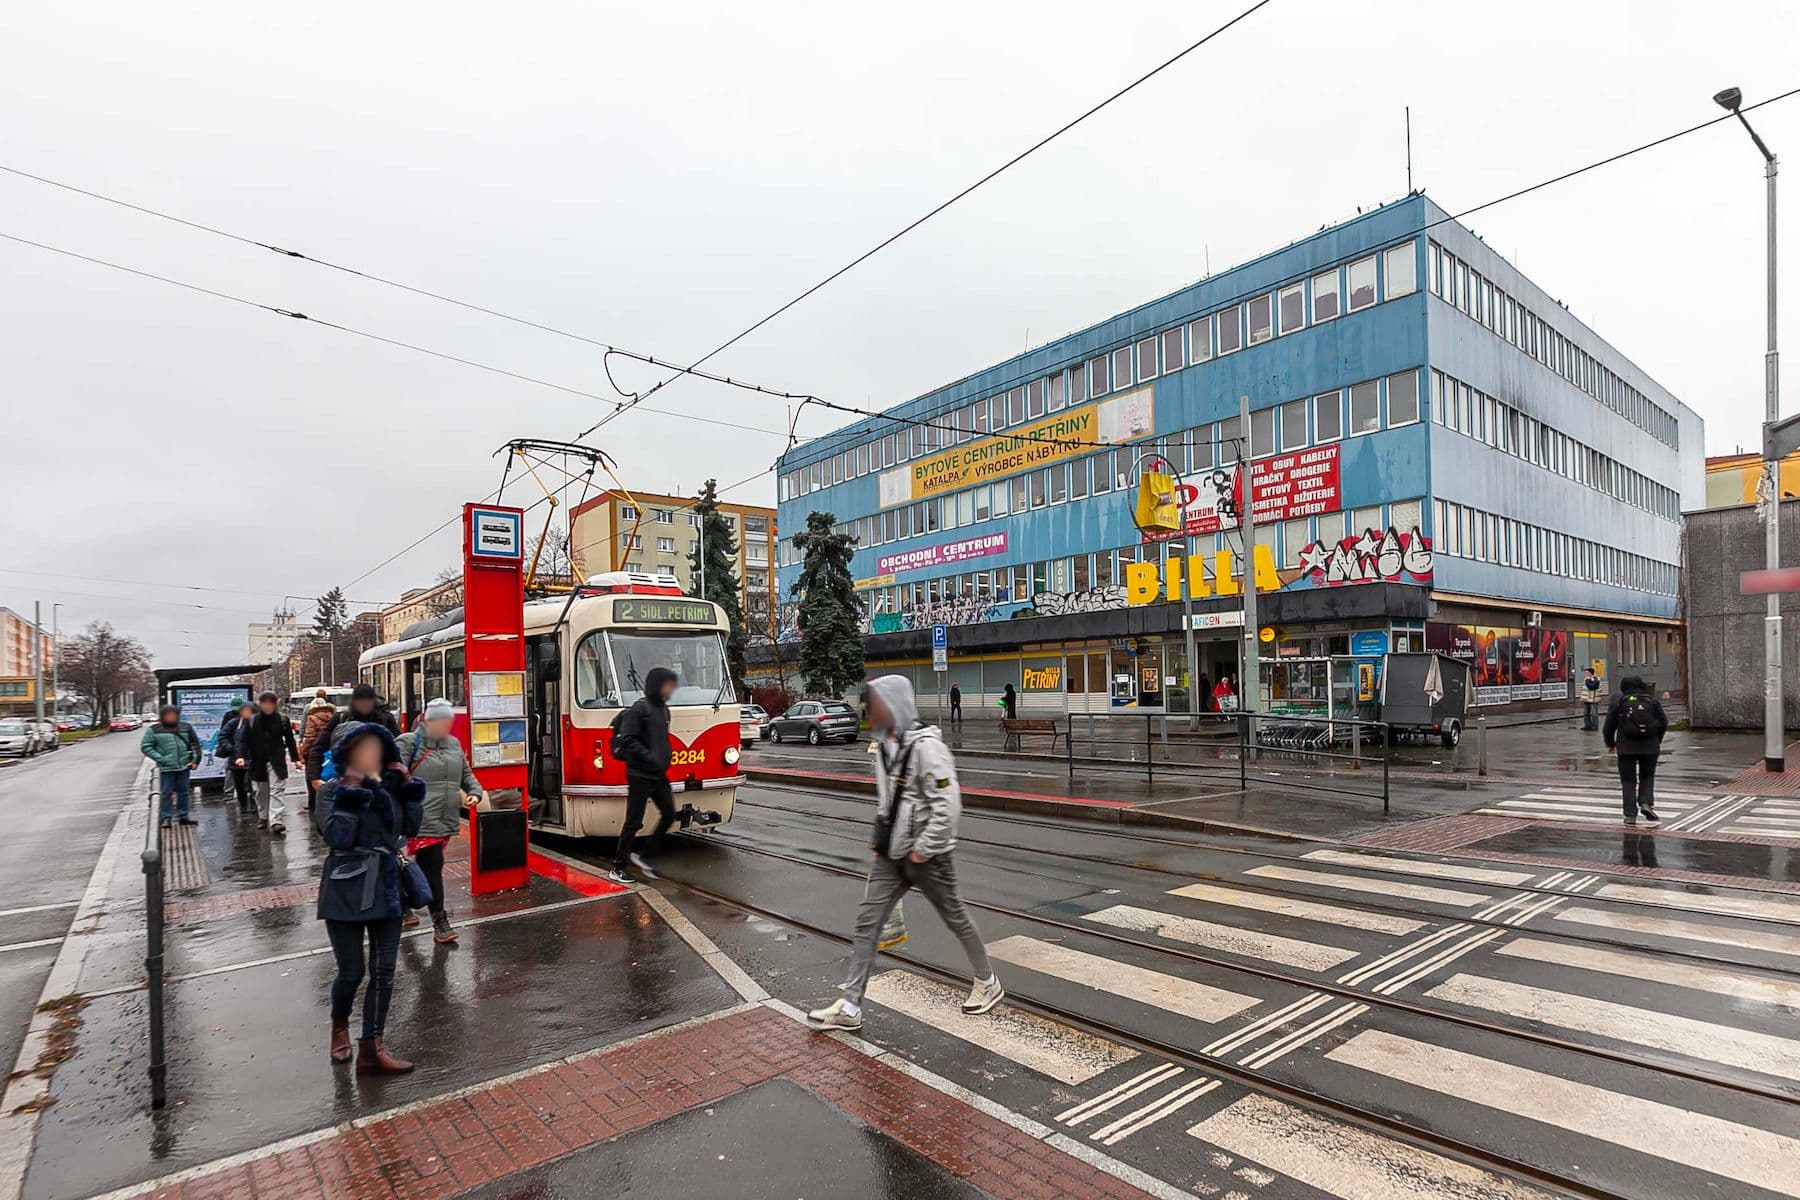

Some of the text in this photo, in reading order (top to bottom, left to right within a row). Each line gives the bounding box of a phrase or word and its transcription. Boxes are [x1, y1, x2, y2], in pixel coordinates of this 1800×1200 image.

[916, 454, 960, 480] BYTOVÉ
[963, 434, 1025, 465] CENTRUM
[1273, 457, 1295, 471] OBUV
[1301, 448, 1337, 465] KABELKY
[923, 470, 960, 490] KATALPA
[975, 454, 1023, 477] VÝROBCE
[1253, 462, 1331, 487] HRAČKY DROGERIE
[1261, 477, 1324, 497] BYTOVÝ TEXTIL
[1294, 486, 1336, 504] BIŽUTERIE
[1253, 501, 1326, 522] DOMÁCÍ POTŘEBY
[880, 546, 937, 569] OBCHODNÍ
[942, 534, 1005, 556] CENTRUM
[1126, 543, 1281, 607] BILLA
[621, 602, 634, 620] 2
[935, 627, 944, 641] P
[670, 749, 705, 766] 3284
